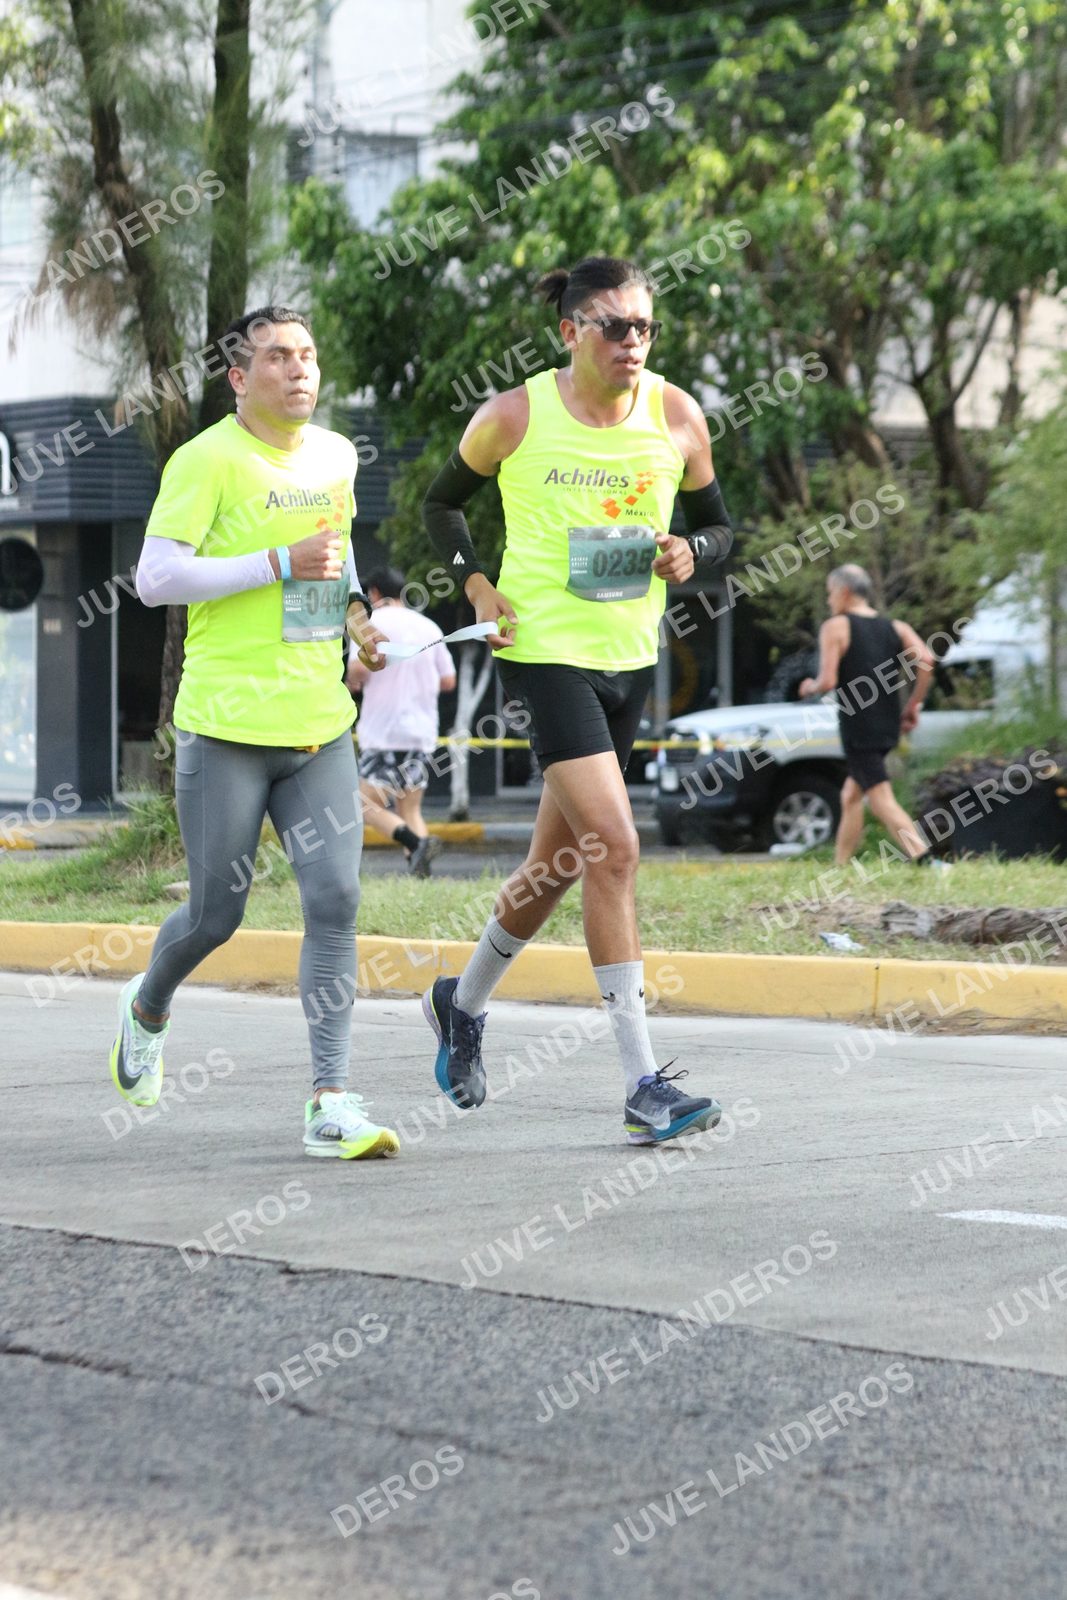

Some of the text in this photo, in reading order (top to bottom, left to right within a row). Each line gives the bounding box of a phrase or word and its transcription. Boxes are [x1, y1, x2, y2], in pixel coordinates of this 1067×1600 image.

[544, 468, 630, 488] Achilles
[265, 488, 331, 509] Achilles
[592, 548, 654, 578] 0235
